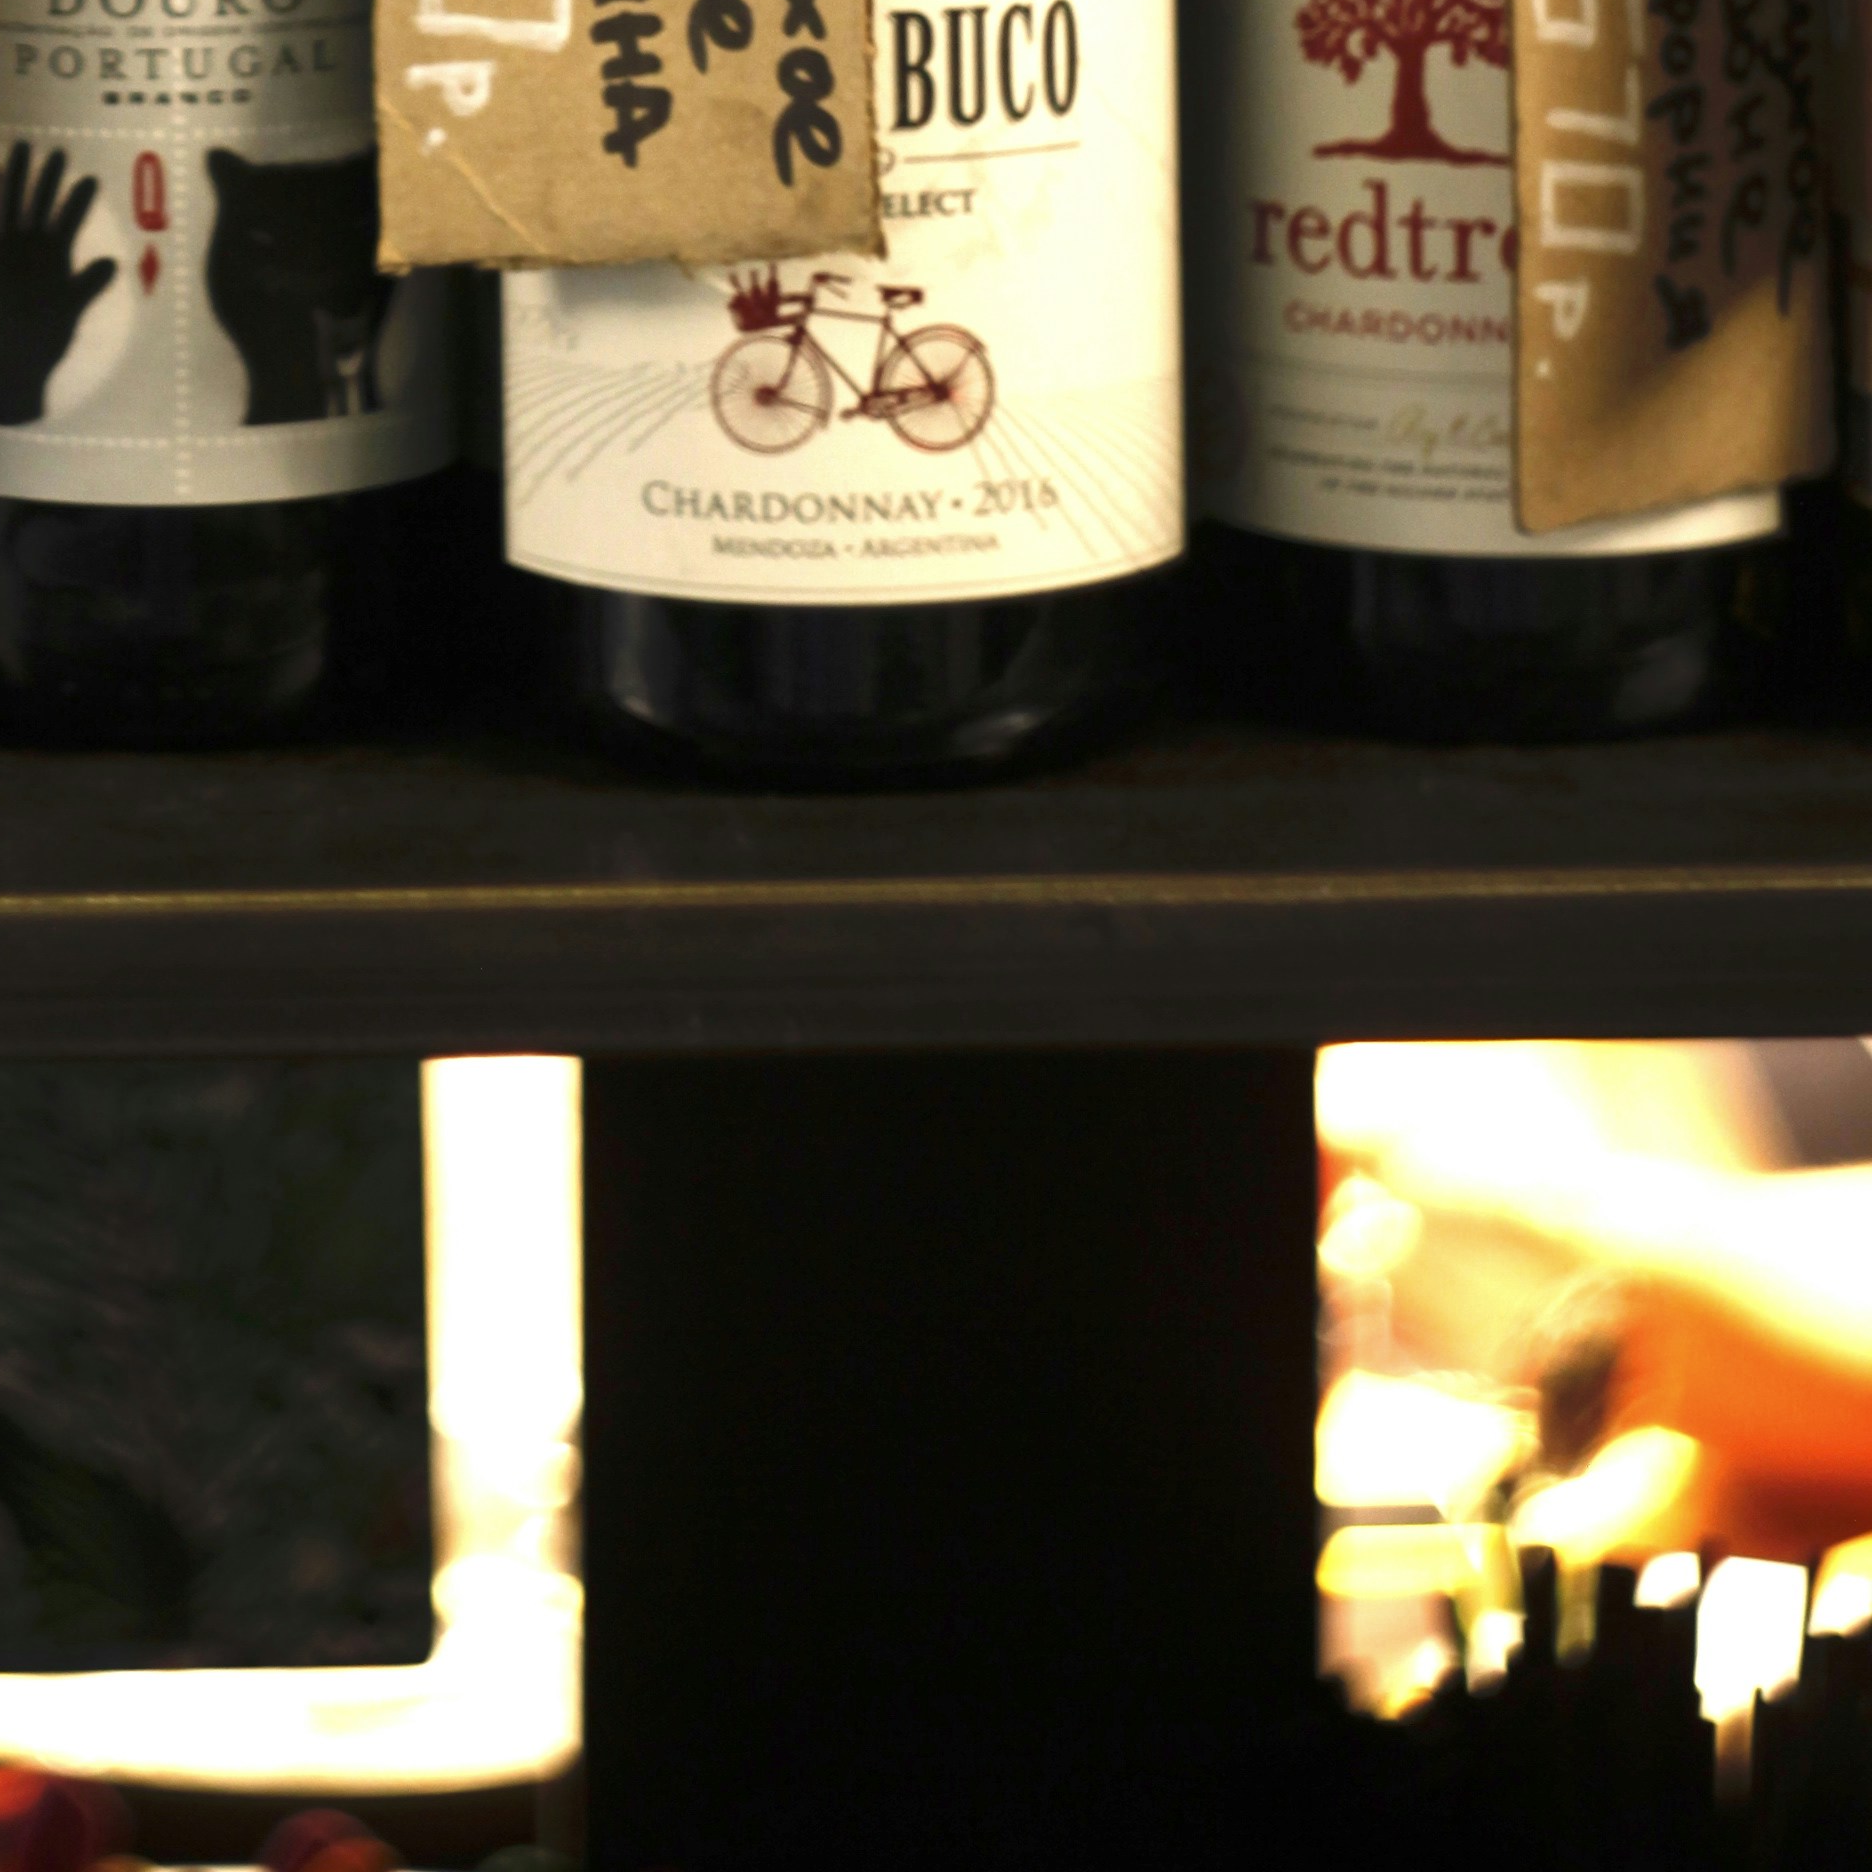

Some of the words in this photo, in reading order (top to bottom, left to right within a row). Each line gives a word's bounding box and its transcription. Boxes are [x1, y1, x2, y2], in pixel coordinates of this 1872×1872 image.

[12, 39, 340, 84] PORTUGAL
[640, 478, 944, 525] CHARDONNAY
[972, 476, 1060, 518] 2016
[710, 532, 838, 559] MENDOZA
[862, 532, 1001, 559] ARGENTINA
